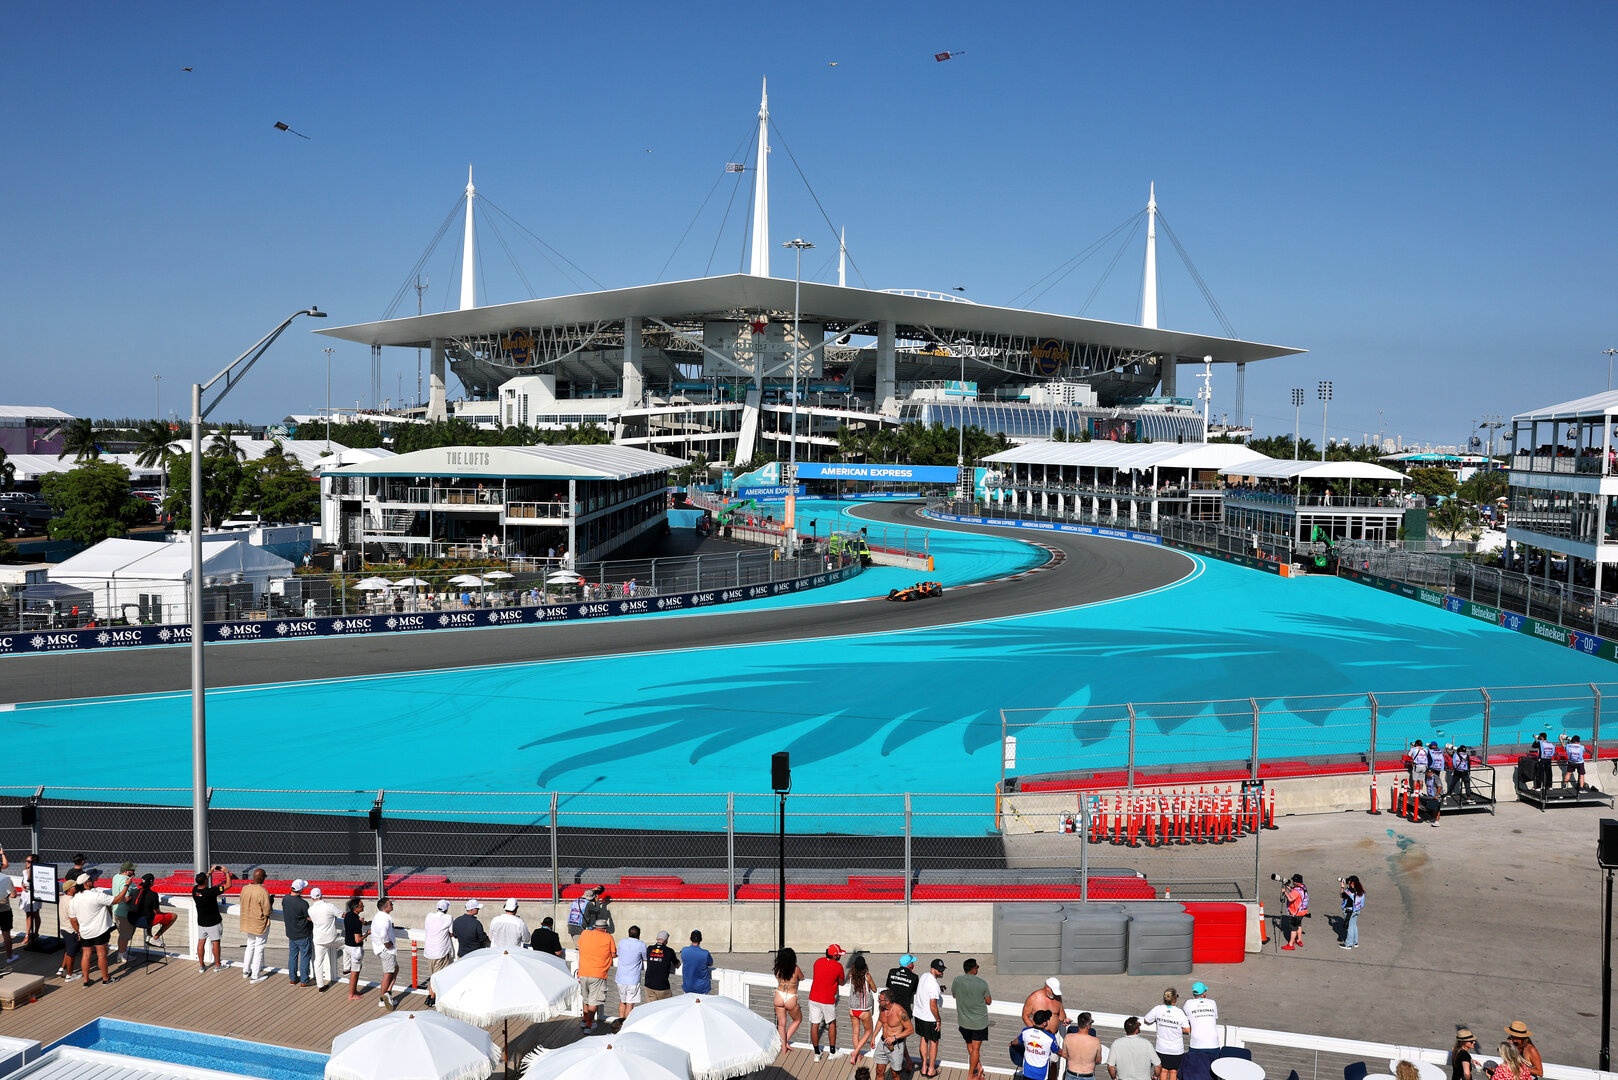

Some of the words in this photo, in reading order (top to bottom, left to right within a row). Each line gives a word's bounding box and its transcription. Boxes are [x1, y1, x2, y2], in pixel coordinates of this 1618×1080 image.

[502, 336, 519, 349] Hard
[1030, 345, 1052, 359] Hard
[447, 452, 462, 465] THE
[464, 452, 489, 466] LOFTS
[762, 462, 778, 481] 4
[821, 468, 868, 476] AMERICAN
[870, 469, 912, 477] EXPRESS
[729, 590, 742, 598] MSC
[1421, 590, 1440, 604] Heineken
[629, 601, 648, 610] MSC
[666, 597, 682, 606] MSC
[547, 607, 567, 616] MSC
[589, 604, 609, 613] MSC
[1472, 604, 1496, 621] Heineken
[451, 614, 474, 622] MSC
[500, 610, 522, 619] MSC
[346, 619, 371, 628] MSC
[400, 616, 424, 625] MSC
[234, 625, 261, 635] MSC
[290, 622, 316, 631] MSC
[112, 631, 142, 641] MSC
[173, 628, 192, 638] MS
[1535, 622, 1565, 642] Heineken
[47, 634, 78, 644] MSC
[1584, 637, 1593, 650] 0.0
